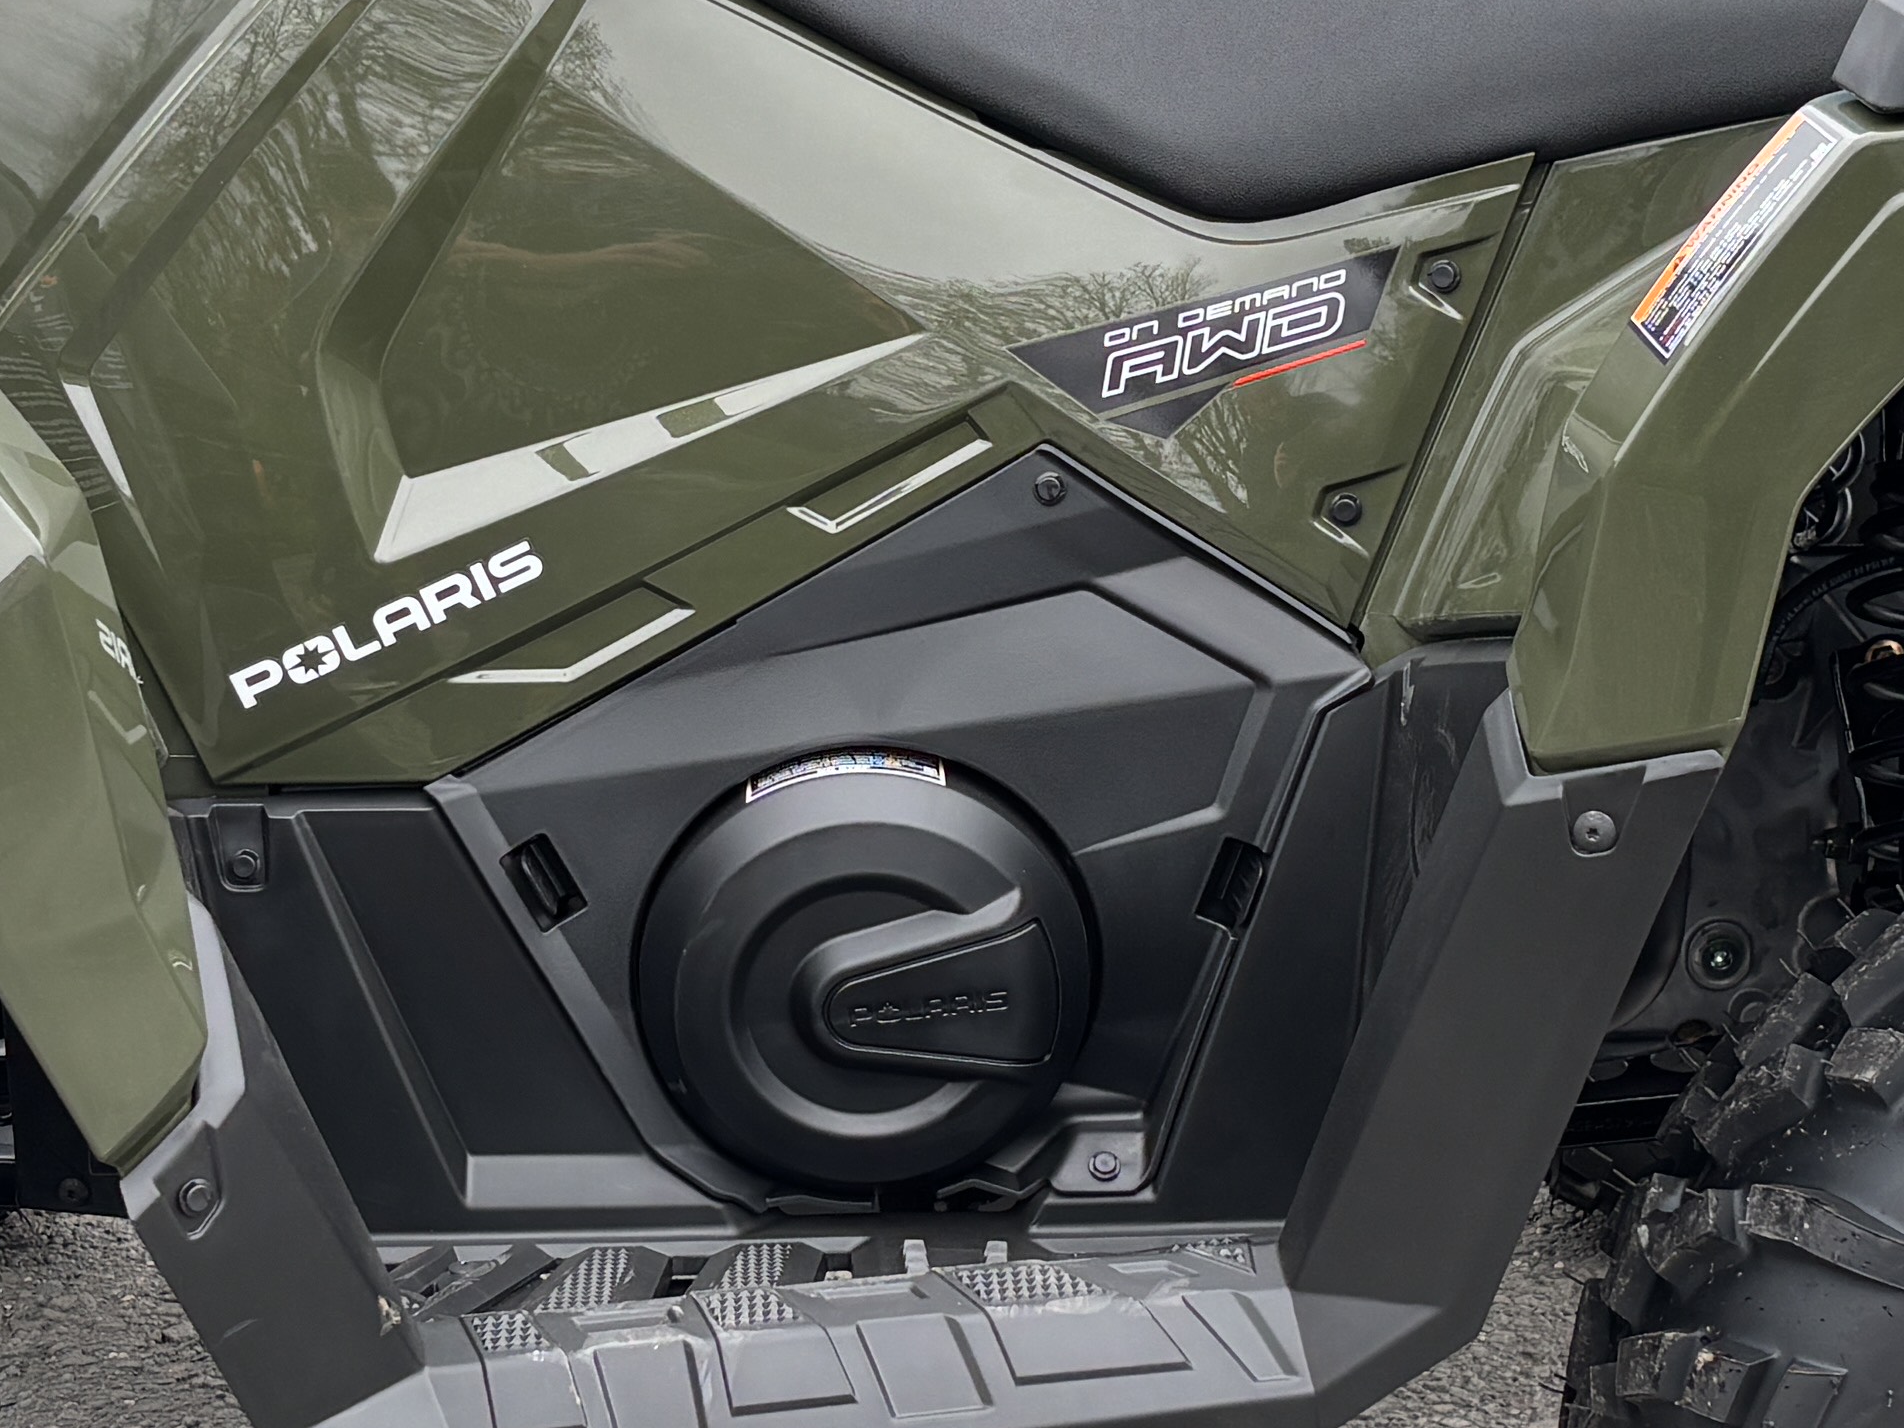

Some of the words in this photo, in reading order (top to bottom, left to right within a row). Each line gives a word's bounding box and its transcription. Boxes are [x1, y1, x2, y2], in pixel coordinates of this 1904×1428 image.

[1100, 293, 1346, 399] AWD
[1103, 318, 1159, 350] ON
[1177, 267, 1348, 329] DEMAND
[229, 538, 545, 709] POLARIS
[847, 988, 1010, 1029] POLARIS
